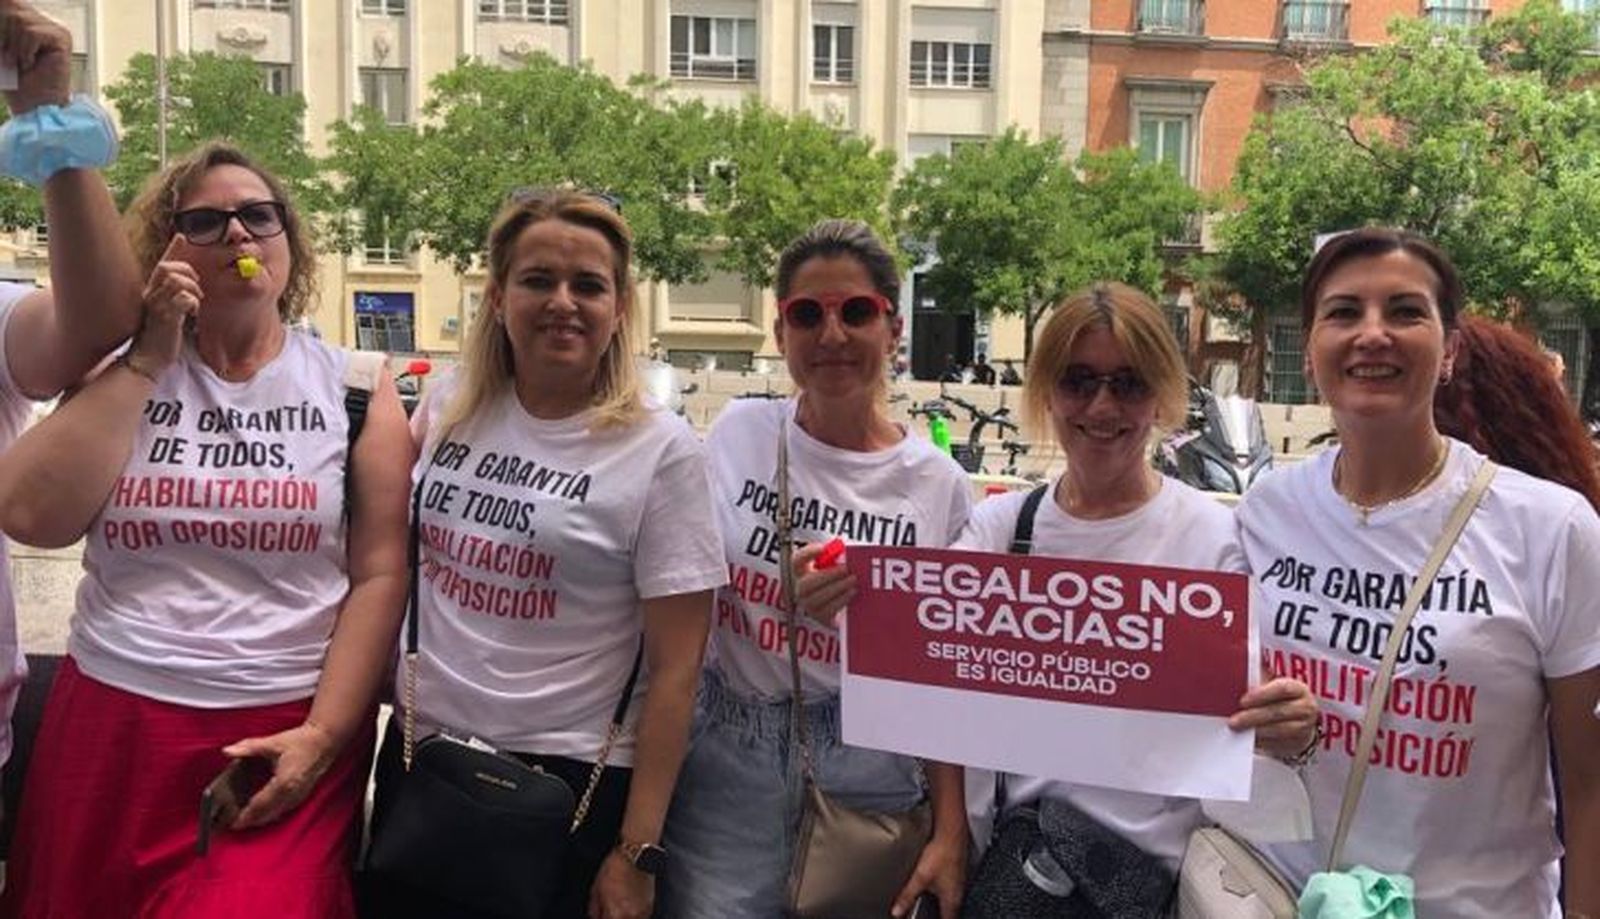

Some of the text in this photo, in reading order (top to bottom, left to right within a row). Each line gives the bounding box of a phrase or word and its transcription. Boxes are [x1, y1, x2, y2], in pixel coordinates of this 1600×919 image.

[198, 401, 327, 434] GARANTÍA
[149, 437, 295, 472] DE TODOS,
[114, 475, 317, 511] HABILITACIÓN
[475, 450, 593, 503] GARANTÍA
[424, 480, 536, 540] DE TODOS,
[736, 479, 917, 547] POR GARANTÍA
[104, 516, 323, 554] POR OPOSICIÓN
[746, 525, 781, 565] DE
[870, 558, 1234, 629] ¡REGALOS NO,
[1260, 556, 1316, 593] POR
[916, 597, 1164, 652] GRACIAS!
[1274, 601, 1319, 642] DE
[925, 641, 1151, 681] SERVICIO PÚBLICO
[956, 662, 1117, 695] ES IGUALDAD
[1261, 647, 1477, 725] ABILITCIÓN
